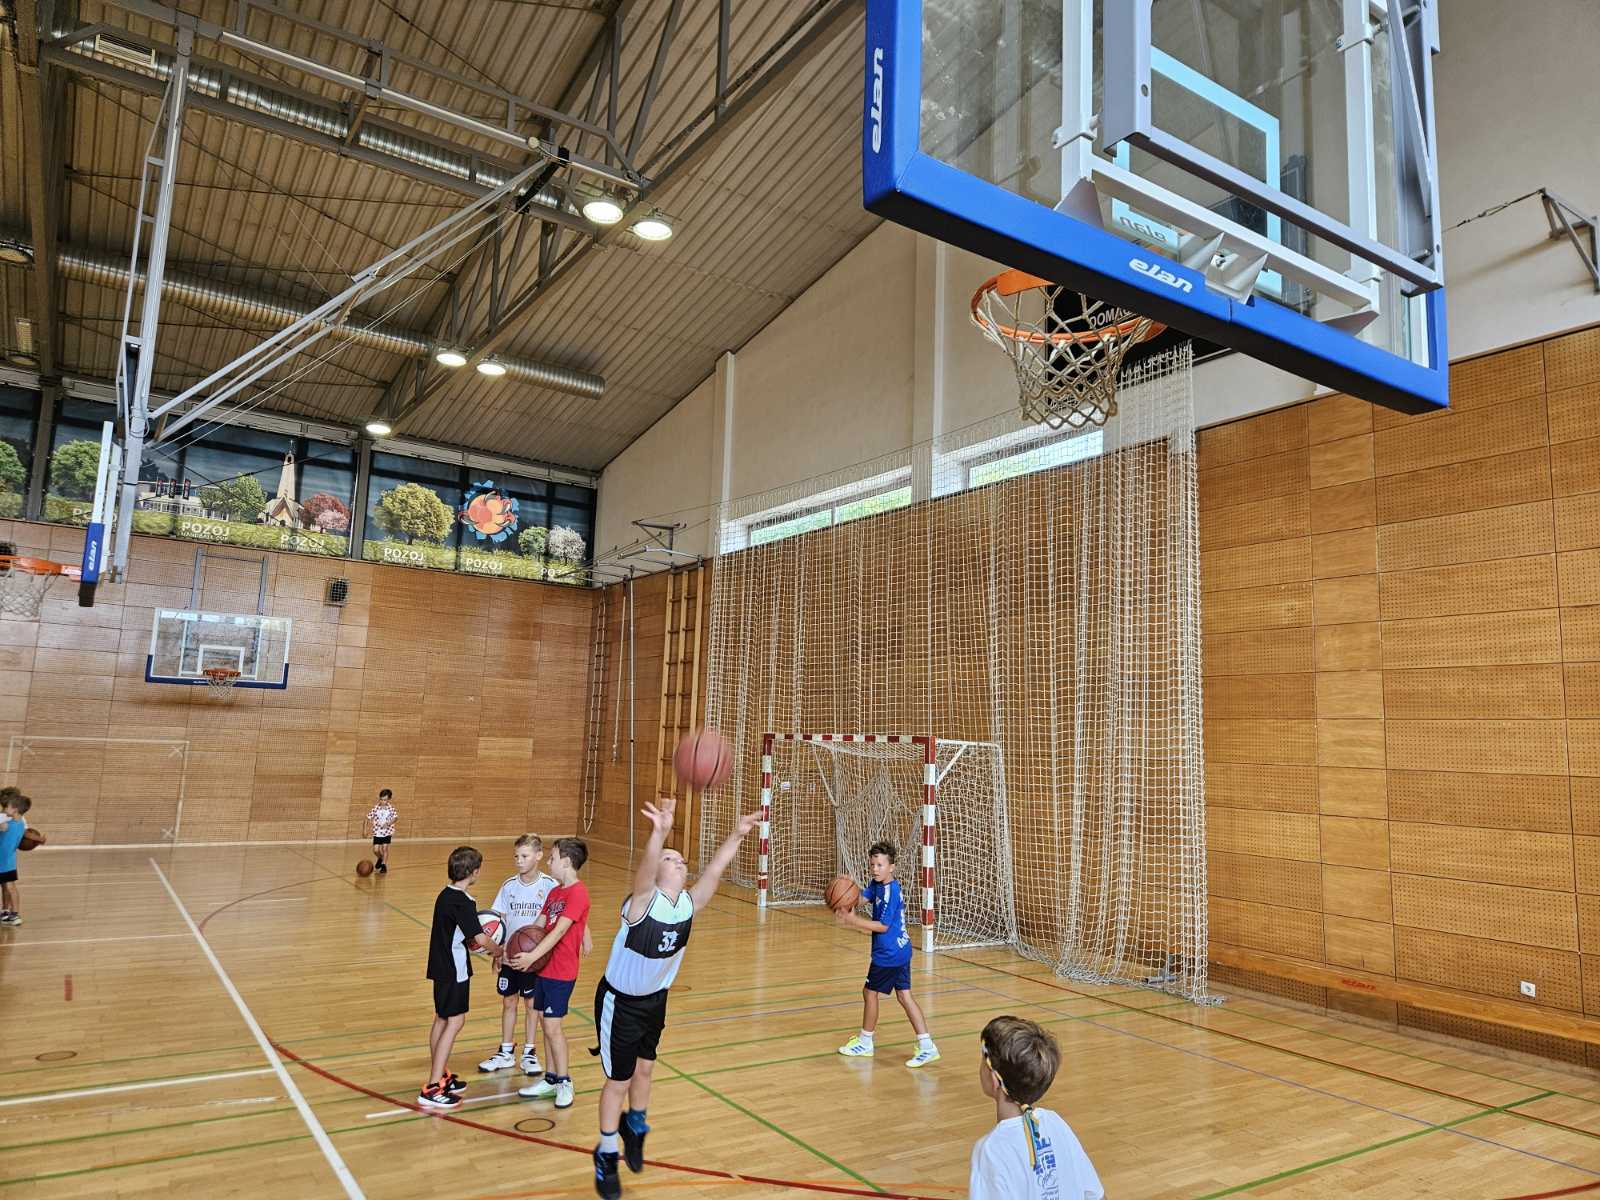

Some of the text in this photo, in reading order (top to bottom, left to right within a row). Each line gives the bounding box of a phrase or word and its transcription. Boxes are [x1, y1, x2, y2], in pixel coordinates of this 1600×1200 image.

[871, 48, 883, 153] elan
[1128, 258, 1193, 293] elan
[181, 522, 230, 537] POZOJ
[280, 534, 325, 548] POZOJ
[88, 540, 97, 571] elan
[384, 547, 424, 561] POZOJ
[466, 558, 503, 570] POZOJ
[510, 901, 543, 910] Emirates
